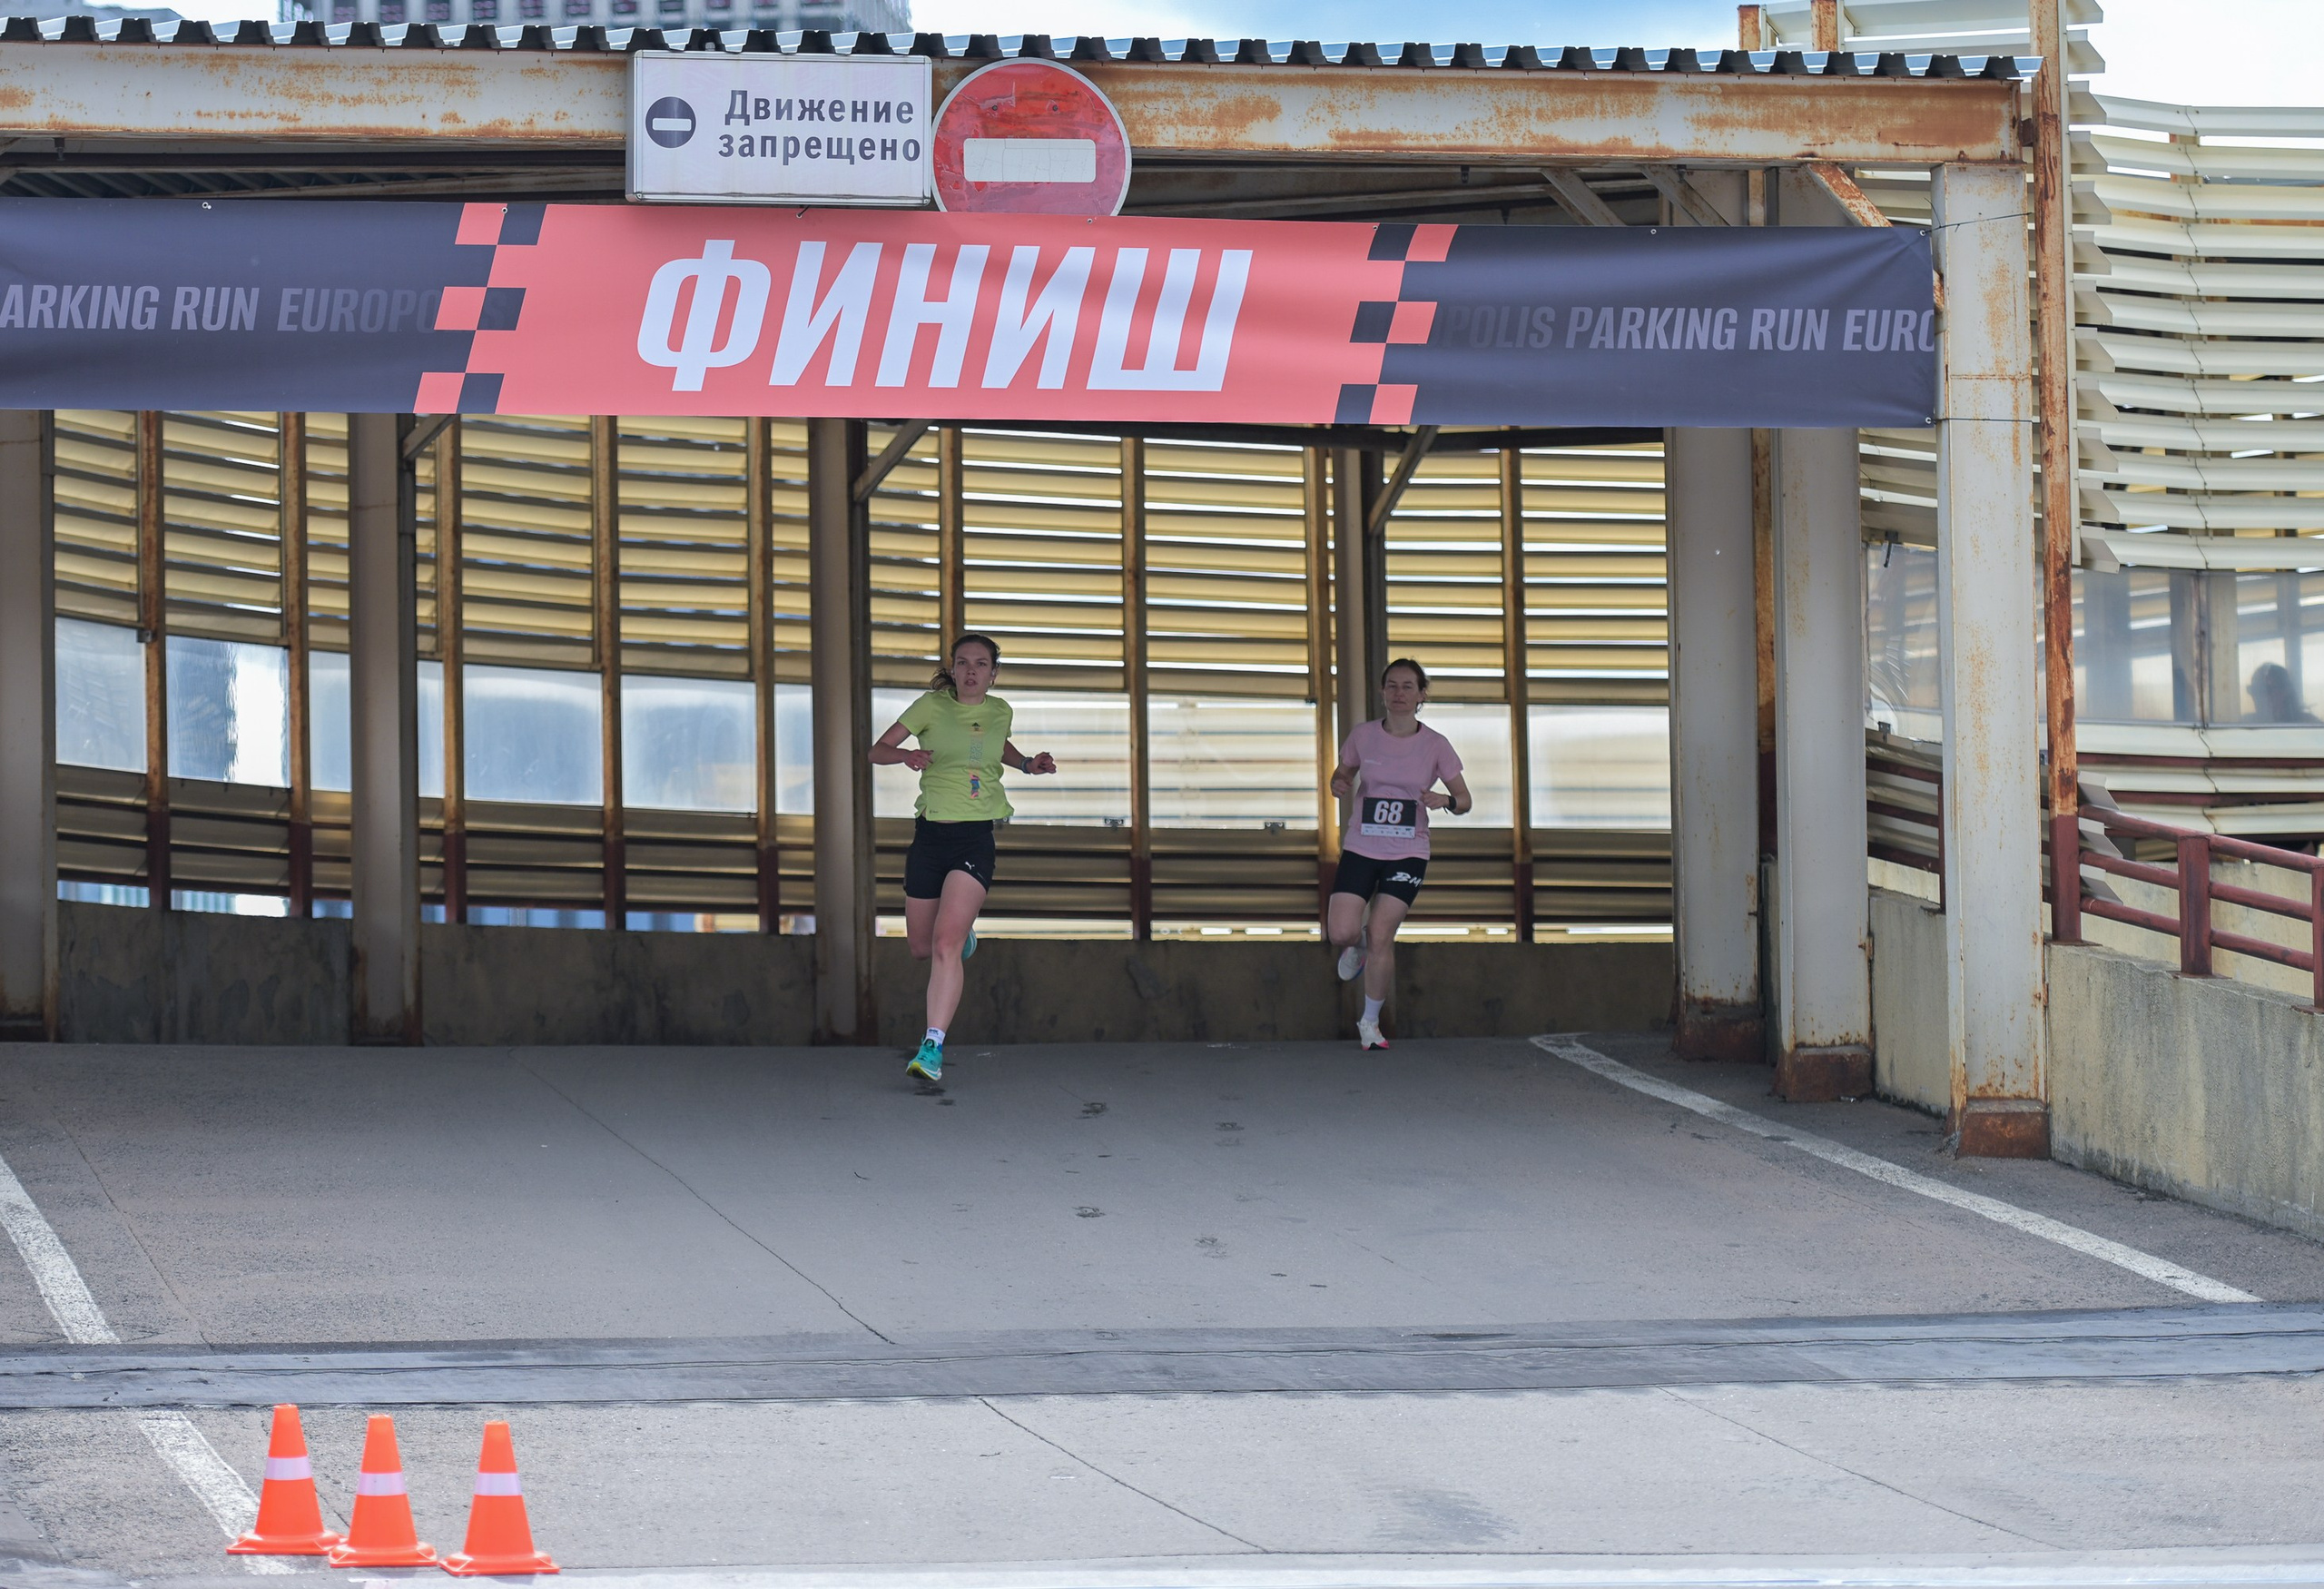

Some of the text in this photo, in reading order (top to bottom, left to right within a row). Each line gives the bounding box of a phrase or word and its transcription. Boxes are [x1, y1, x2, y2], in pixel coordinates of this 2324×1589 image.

[724, 89, 914, 126] Движение
[718, 131, 921, 165] запрещено
[171, 286, 261, 331] RUN
[636, 239, 1254, 392] ФИНИШ
[1565, 306, 1738, 351] PARKING
[1748, 307, 1830, 352] RUN
[1374, 800, 1403, 824] 68
